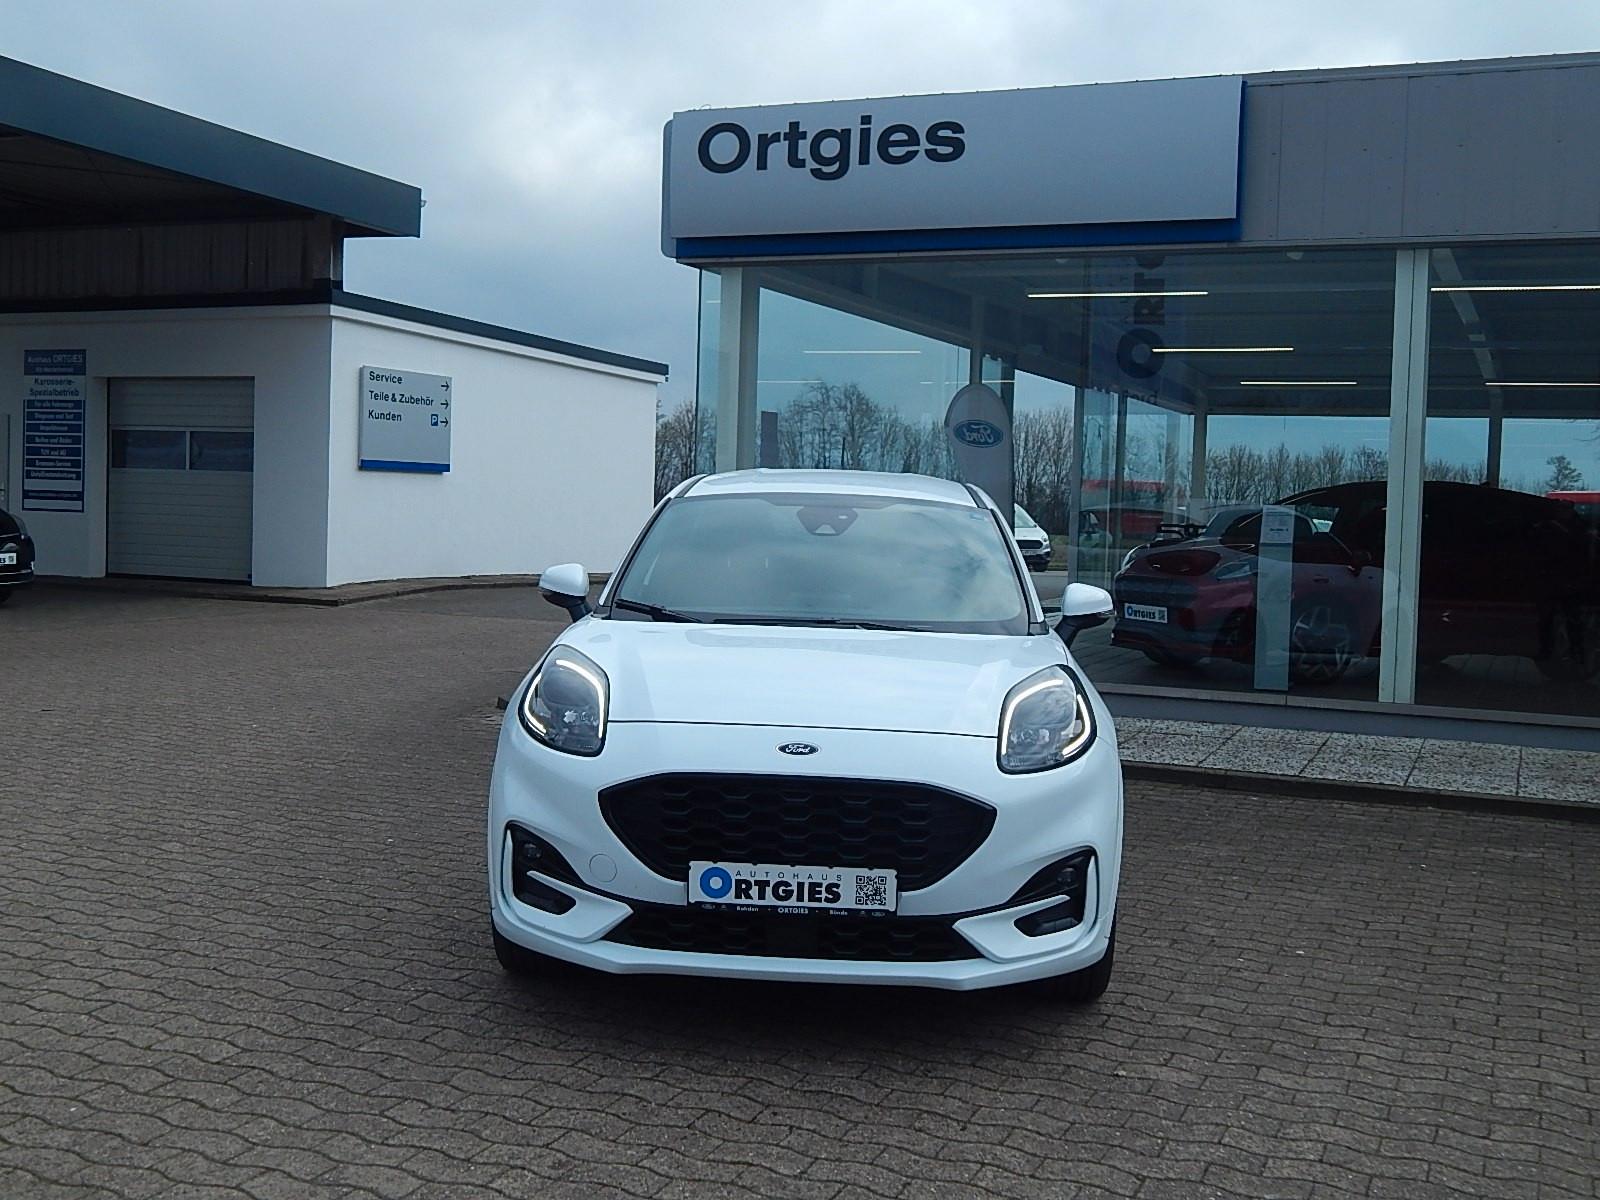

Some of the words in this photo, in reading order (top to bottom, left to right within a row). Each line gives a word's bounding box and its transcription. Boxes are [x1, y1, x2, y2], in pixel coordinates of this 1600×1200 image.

[698, 115, 966, 181] Ortgies
[369, 371, 403, 384] Service
[369, 390, 390, 402] Teile
[390, 393, 397, 402] &
[399, 393, 434, 406] Zubehör
[368, 409, 402, 422] Kunden
[735, 870, 842, 882] AUTOHAUS
[700, 866, 842, 904] ORTGIES
[777, 907, 809, 915] ORTGIES
